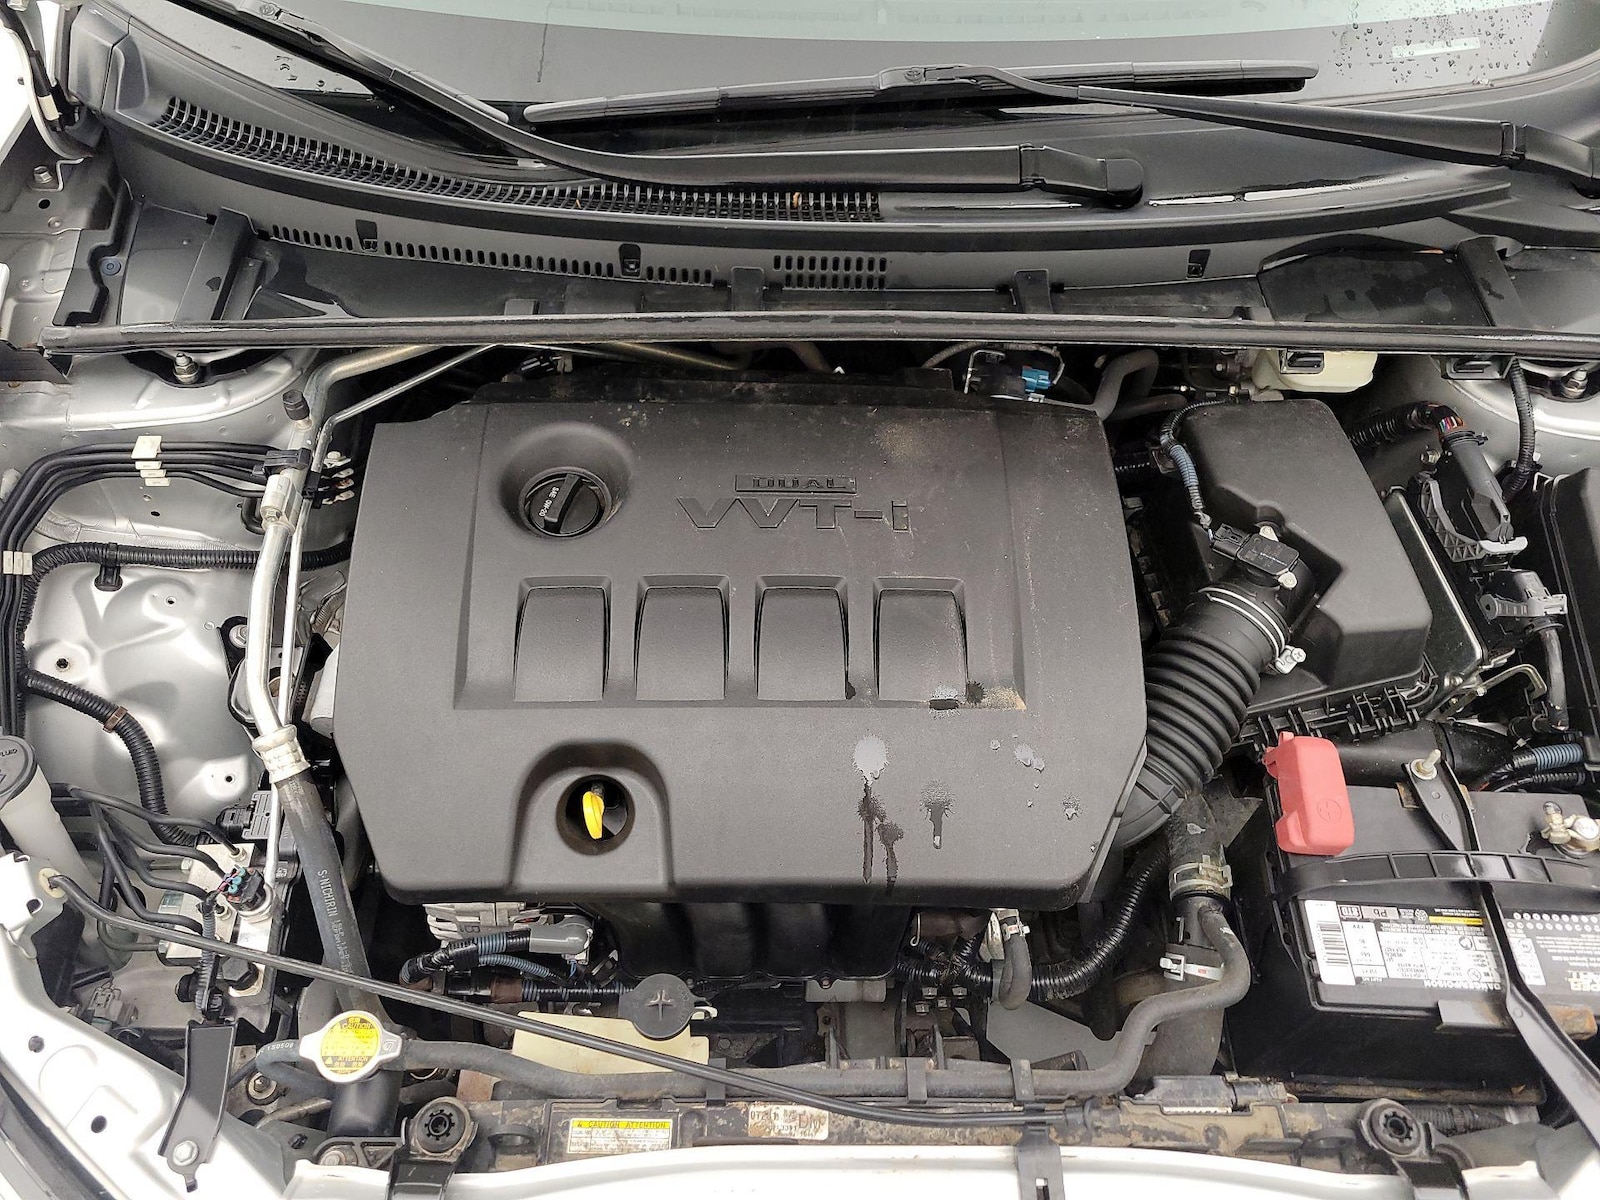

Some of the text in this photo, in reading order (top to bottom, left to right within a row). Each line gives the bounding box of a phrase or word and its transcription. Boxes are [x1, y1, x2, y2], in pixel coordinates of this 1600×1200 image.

[753, 476, 847, 489] DUAL
[1373, 908, 1388, 917] Pb
[588, 1120, 667, 1129] CAUTION ATTENTION
